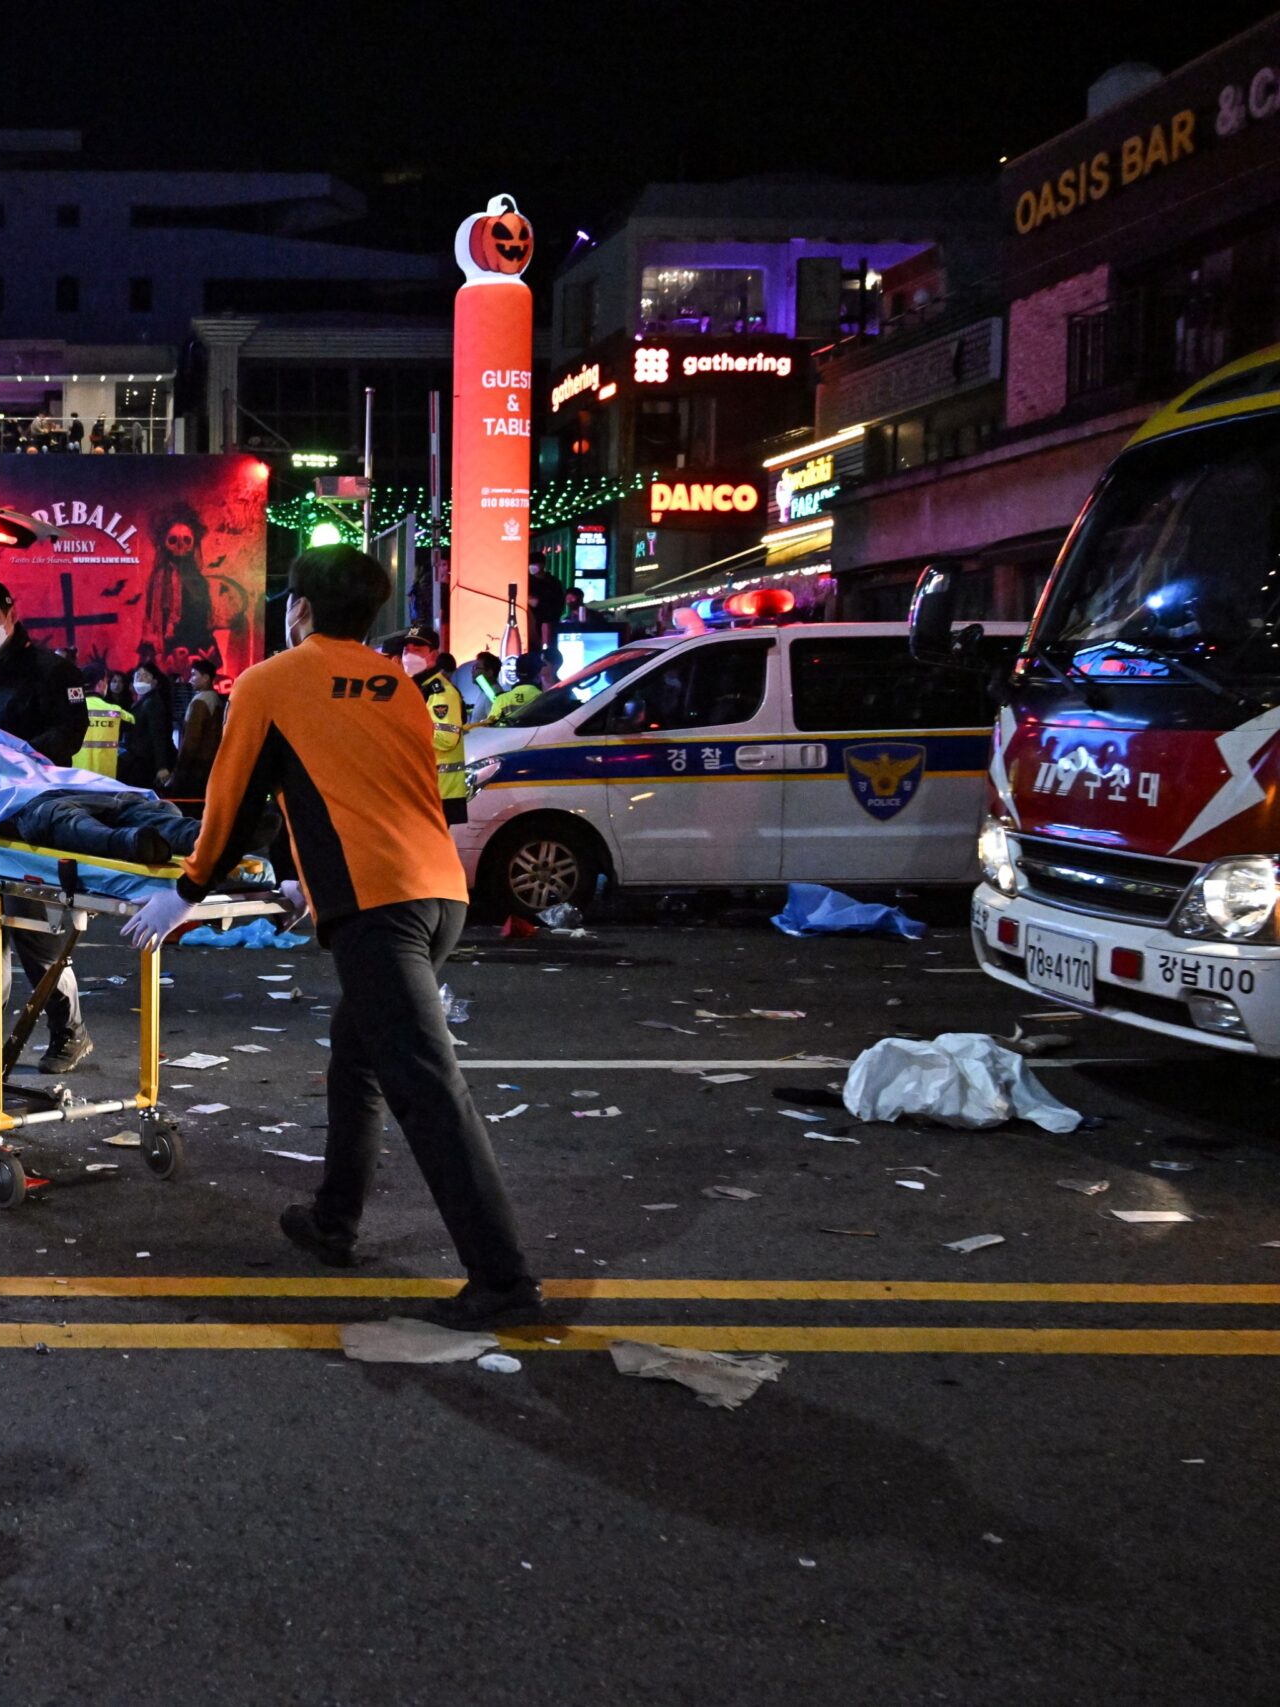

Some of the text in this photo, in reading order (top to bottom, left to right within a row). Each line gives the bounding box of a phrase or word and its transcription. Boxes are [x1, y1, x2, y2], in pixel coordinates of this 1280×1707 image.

[1015, 151, 1111, 235] OASIS
[1121, 109, 1195, 186] BAR
[682, 352, 792, 377] gathering
[481, 369, 532, 389] GUEST
[551, 364, 601, 413] gathering
[507, 394, 519, 412] &
[483, 418, 531, 437] TABLE
[651, 484, 758, 512] DANCO
[31, 500, 137, 550] REBALL
[53, 540, 96, 553] WHISKY
[331, 674, 399, 702] 119
[89, 720, 115, 728] LICE
[867, 797, 901, 807] POLICE
